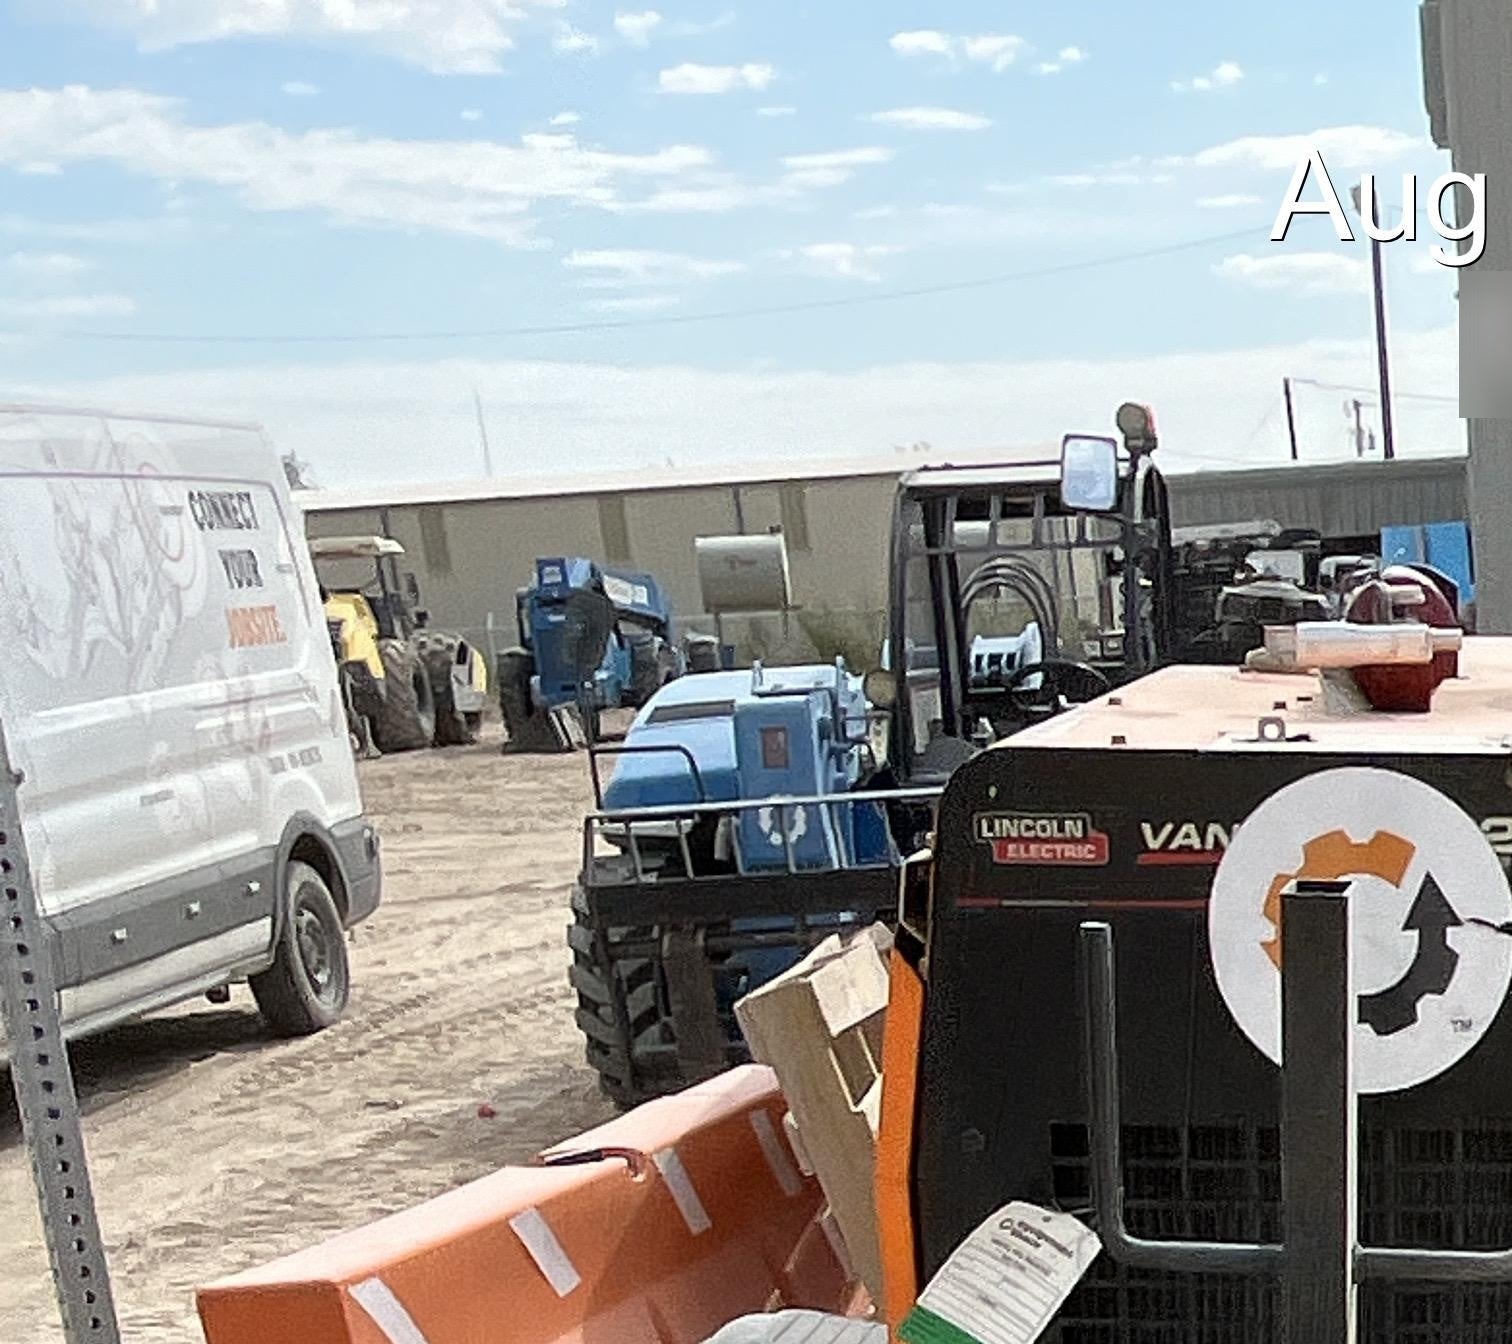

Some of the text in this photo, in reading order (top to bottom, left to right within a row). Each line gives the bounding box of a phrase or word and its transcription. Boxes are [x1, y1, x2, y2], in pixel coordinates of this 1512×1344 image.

[188, 490, 259, 531] CONNECT
[981, 818, 1083, 838] LINCOLN
[1006, 843, 1097, 859] ELECTRIC
